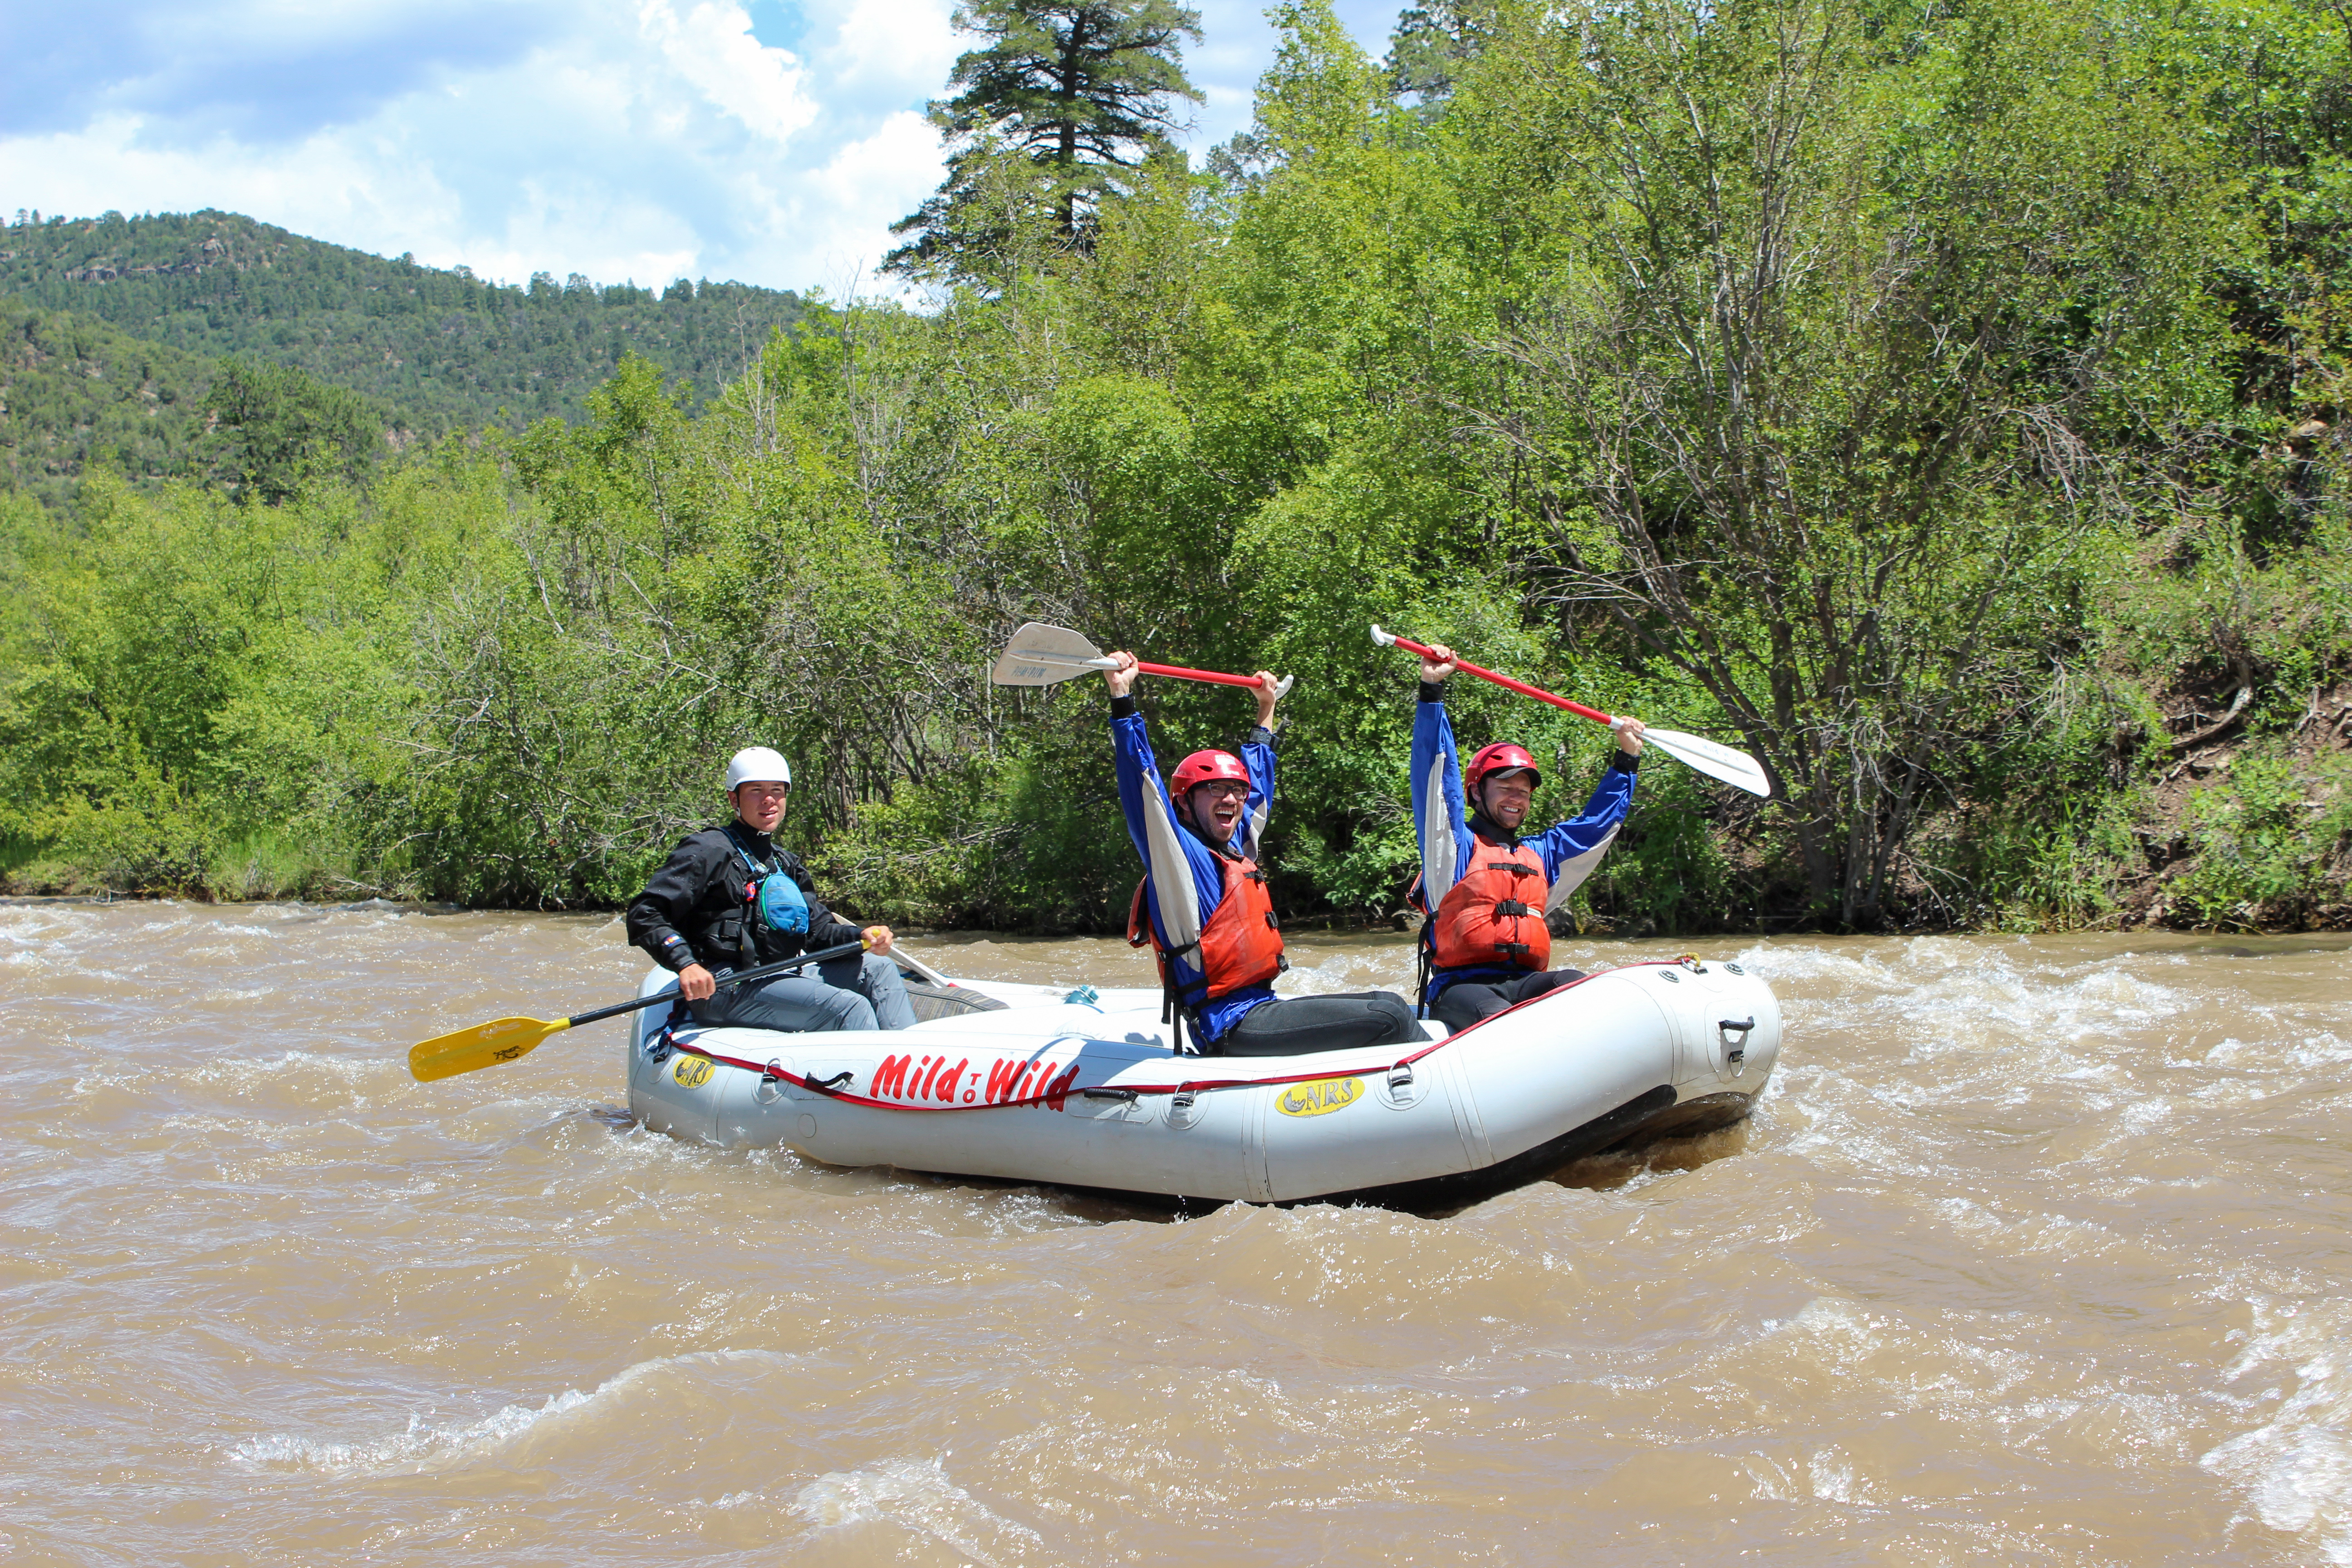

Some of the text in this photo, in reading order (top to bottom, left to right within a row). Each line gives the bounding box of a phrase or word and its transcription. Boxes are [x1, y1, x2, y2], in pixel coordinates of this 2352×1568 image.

[681, 1059, 715, 1087] NRS
[869, 1054, 969, 1103] Mild
[985, 1058, 1080, 1112] Wild
[1305, 1079, 1353, 1111] NRS
